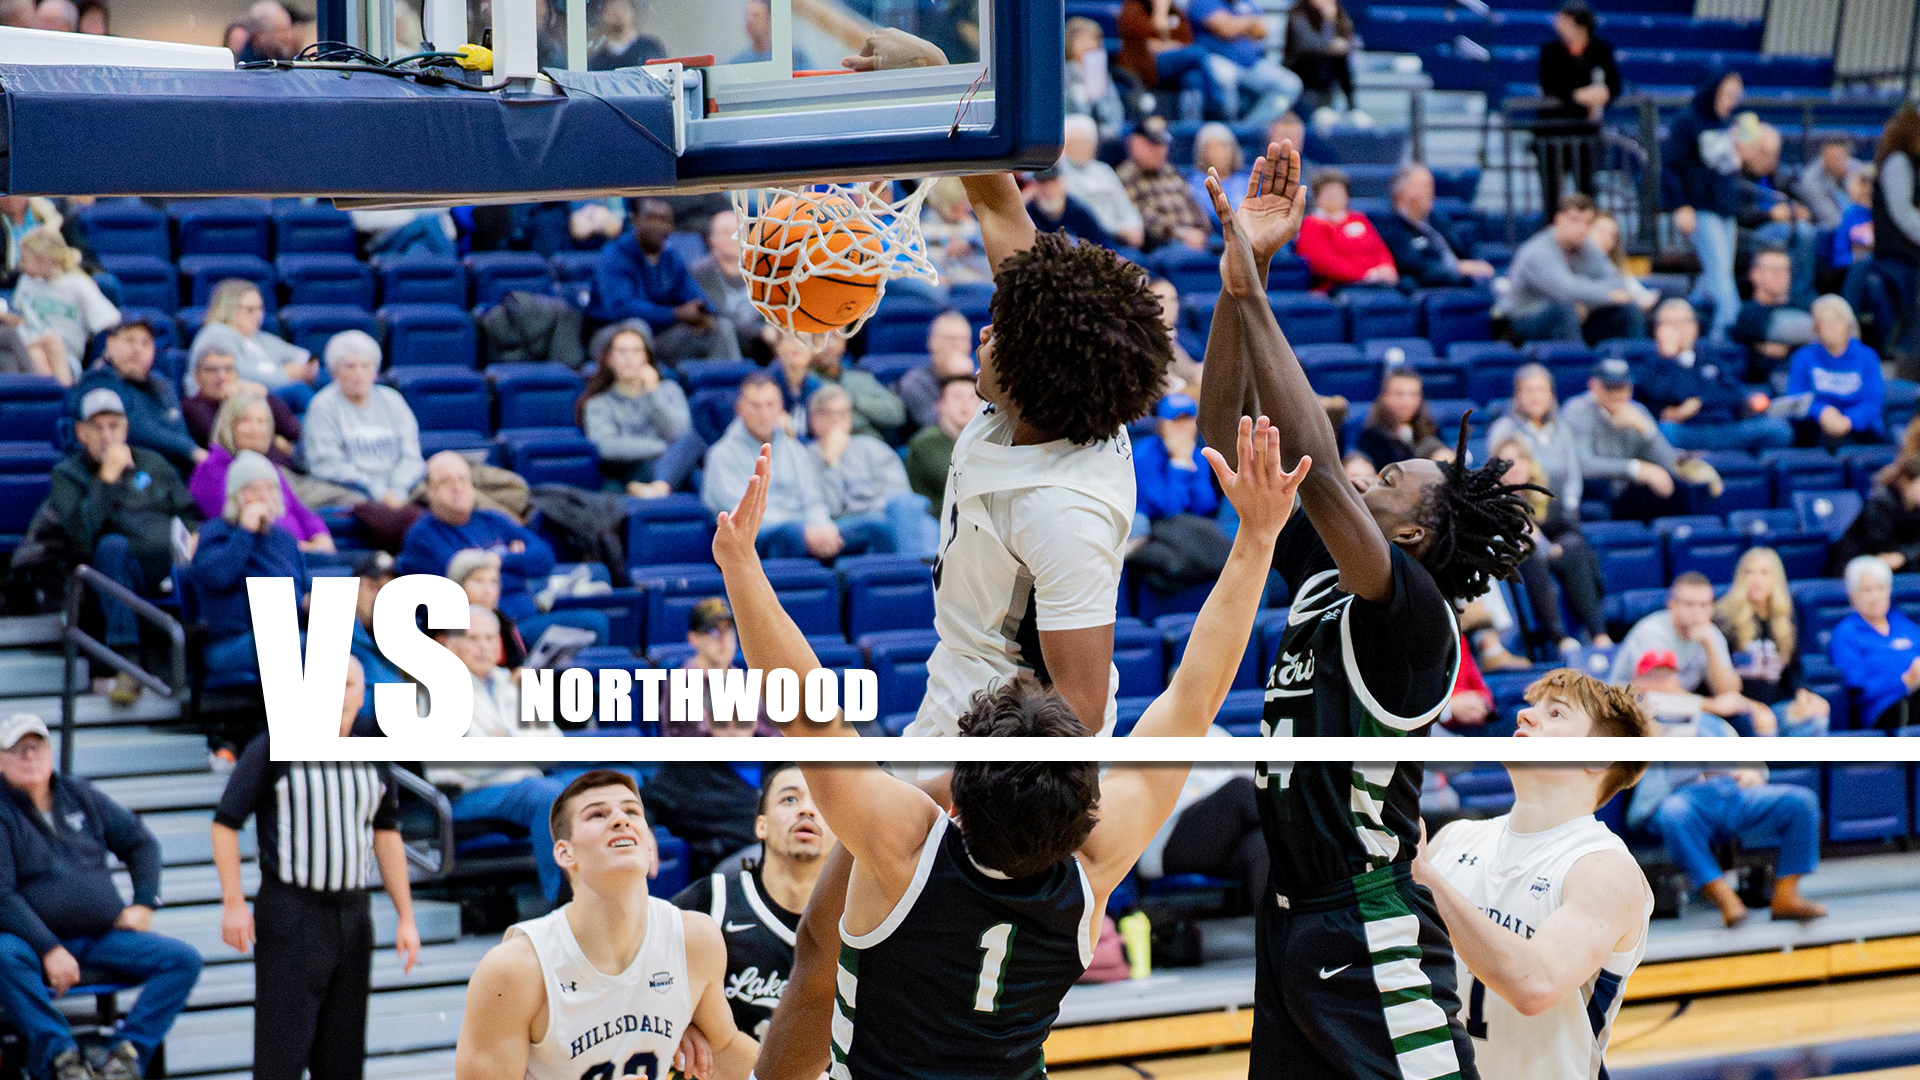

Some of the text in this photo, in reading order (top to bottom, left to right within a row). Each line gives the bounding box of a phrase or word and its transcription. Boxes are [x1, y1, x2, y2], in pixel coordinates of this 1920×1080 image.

[1477, 906, 1536, 940] DALE
[974, 922, 1014, 1013] 1
[570, 1014, 674, 1060] HILLSDALE
